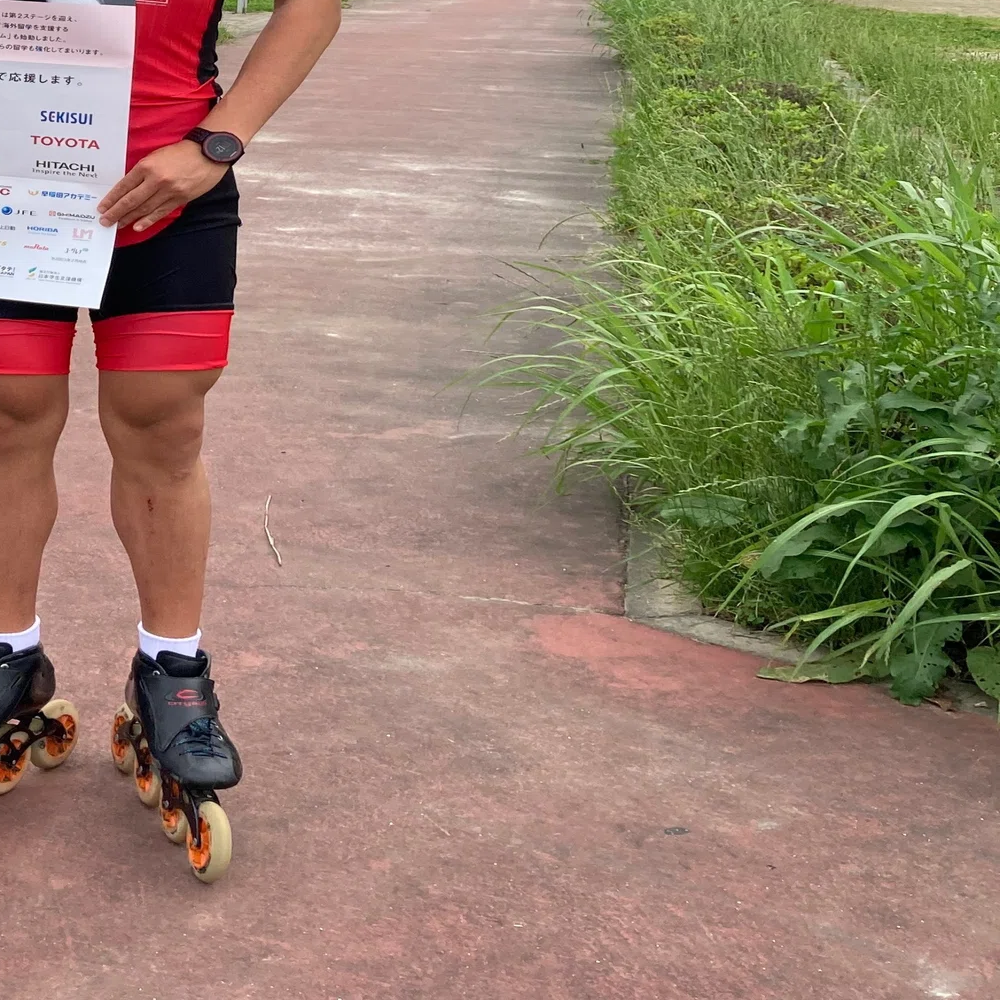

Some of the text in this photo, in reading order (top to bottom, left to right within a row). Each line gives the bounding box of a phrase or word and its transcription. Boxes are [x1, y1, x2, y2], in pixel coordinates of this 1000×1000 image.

[40, 110, 93, 125] SEKISUI
[30, 135, 100, 150] TOYOTA
[36, 160, 96, 173] HITACHI
[32, 168, 61, 177] Inspire
[78, 171, 98, 179] Next
[41, 190, 98, 201] 早稲田アカデミー
[56, 212, 96, 220] SHIMADZU
[27, 225, 59, 233] HORIBA
